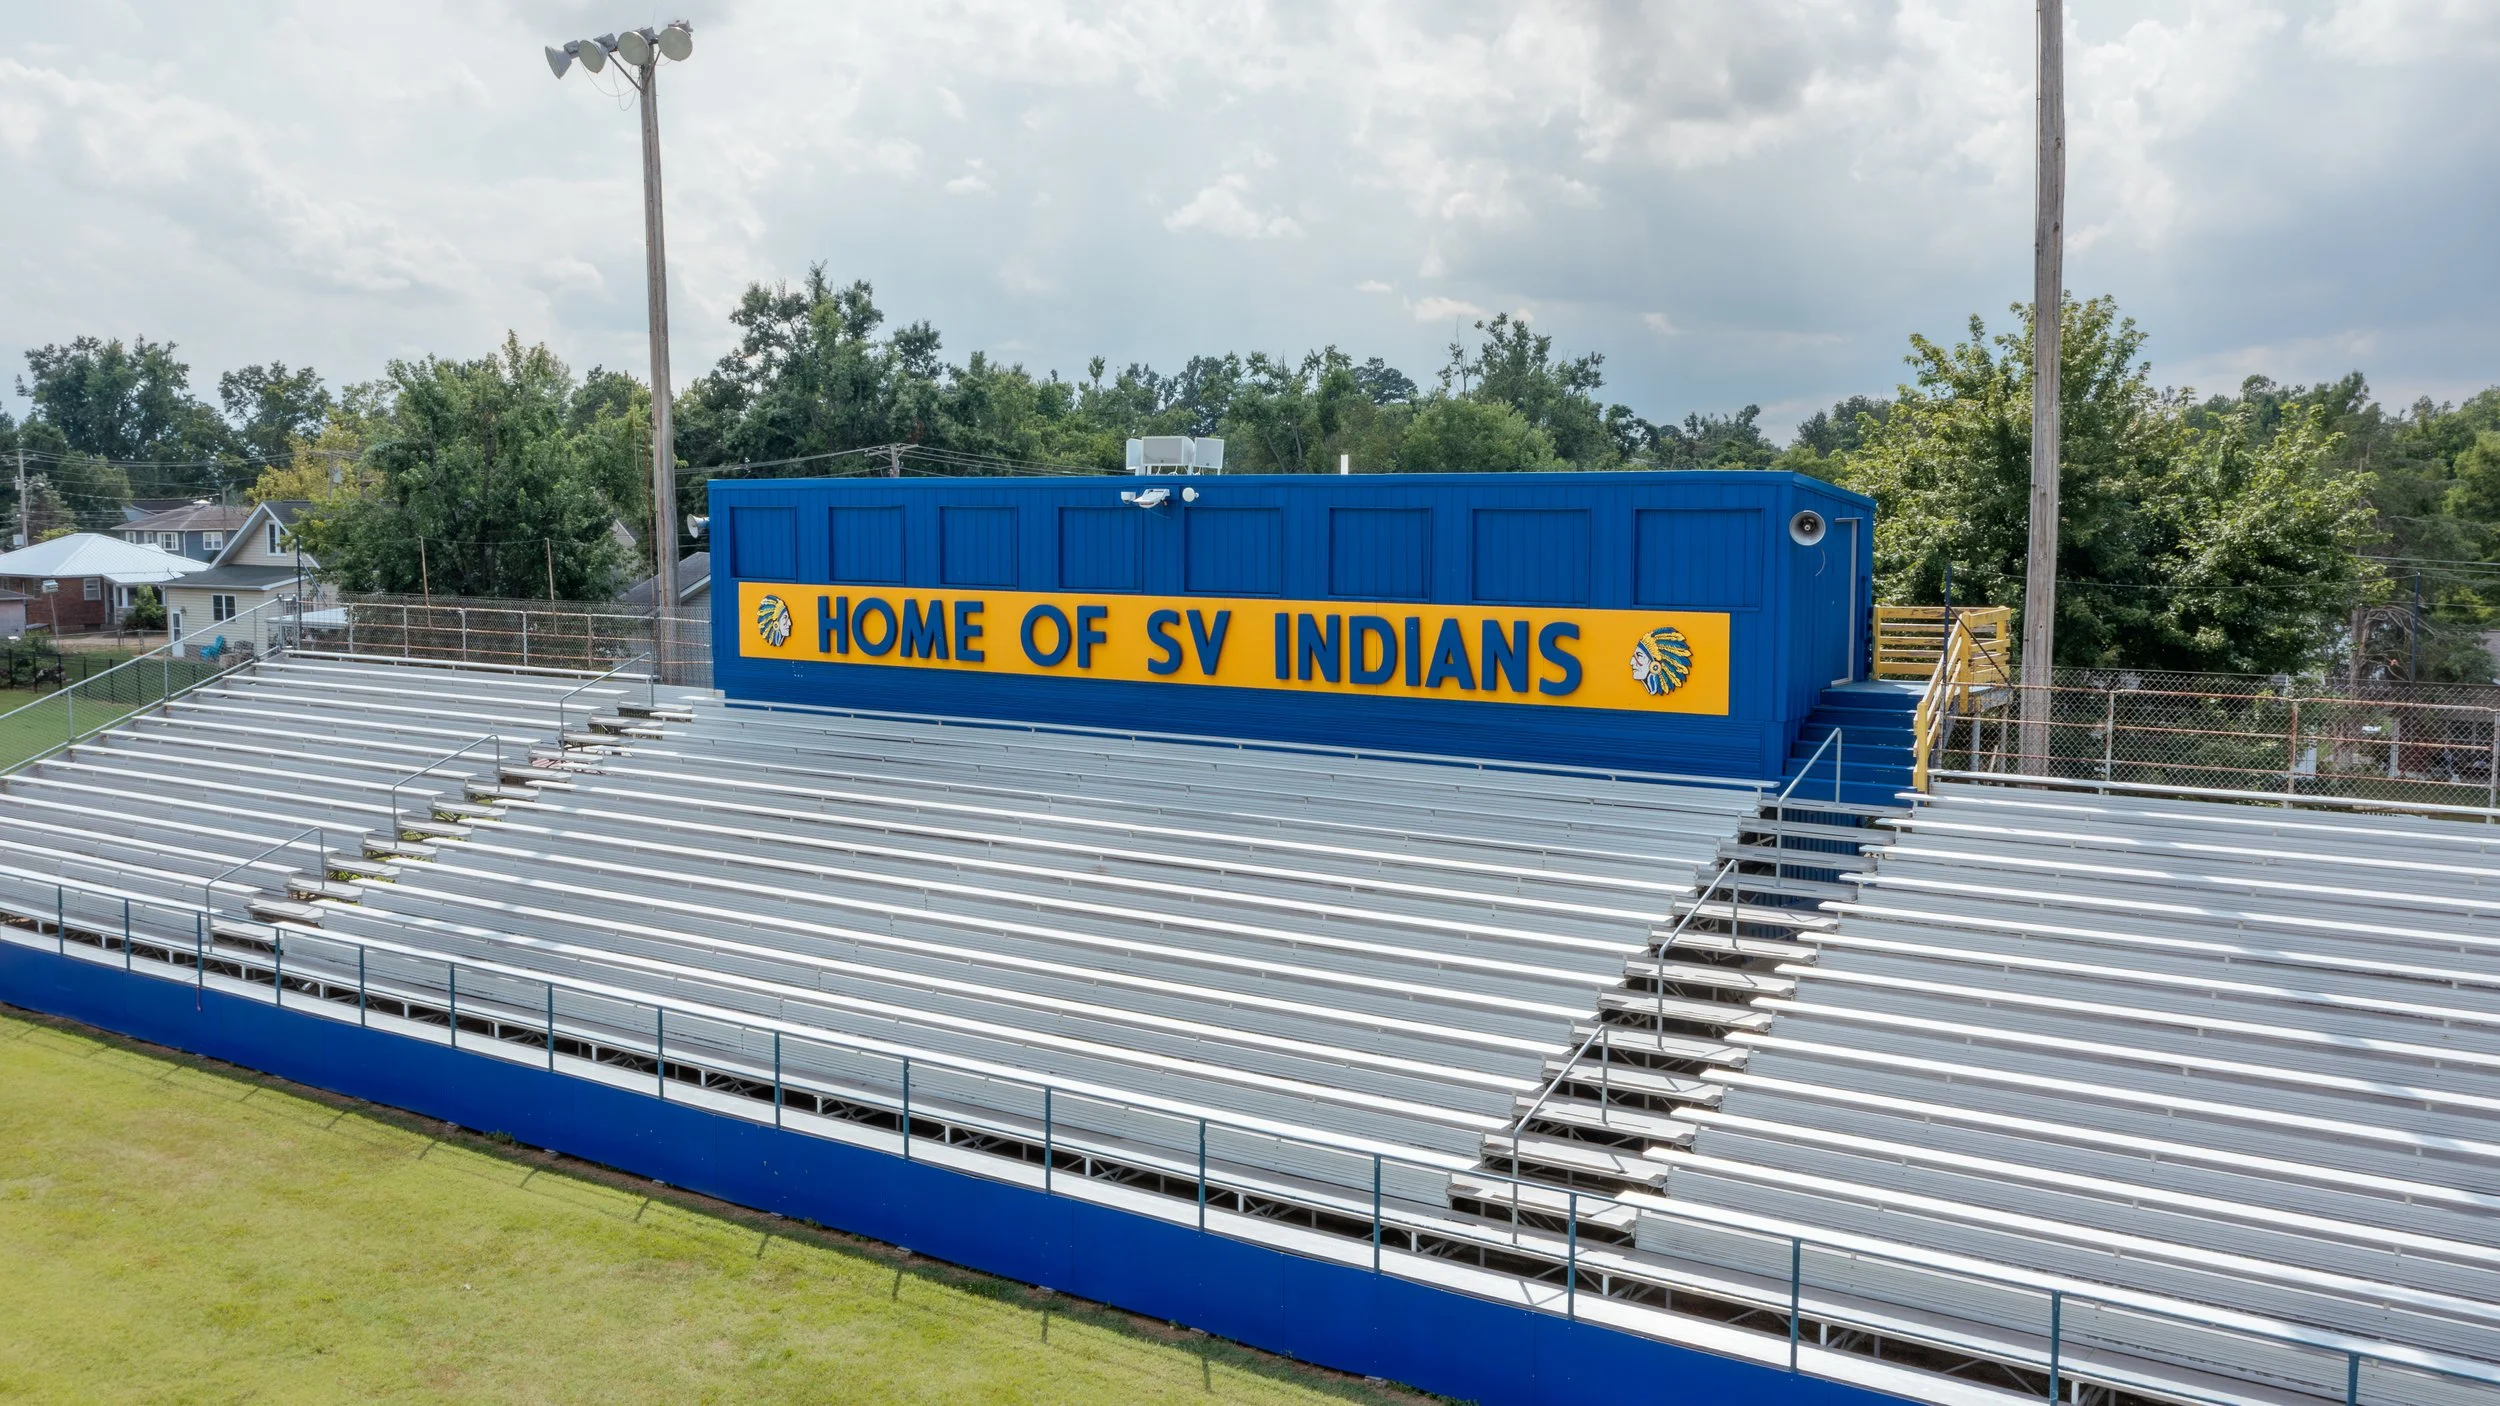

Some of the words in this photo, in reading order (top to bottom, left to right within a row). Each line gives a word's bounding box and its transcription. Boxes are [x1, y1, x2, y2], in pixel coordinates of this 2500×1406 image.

[817, 596, 985, 662] HOME
[1020, 604, 1107, 668] OF
[1146, 609, 1231, 676] SV
[1275, 612, 1583, 696] INDIANS
